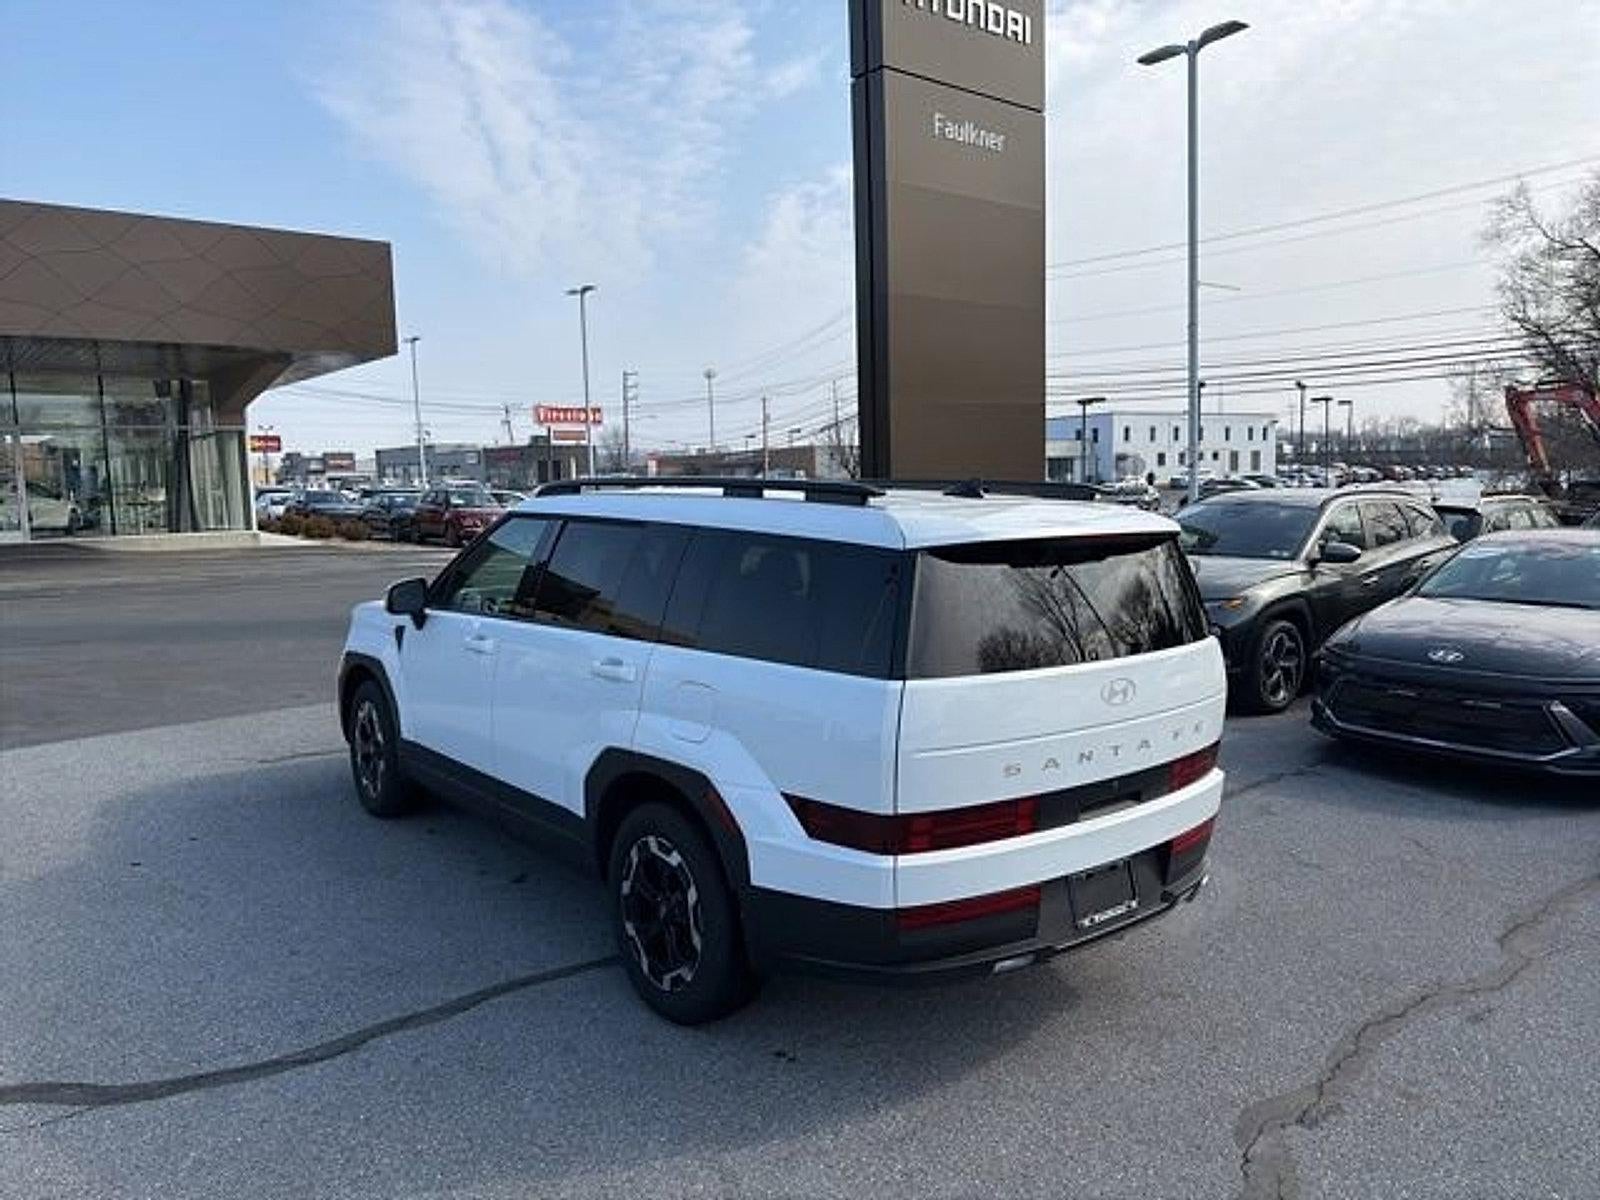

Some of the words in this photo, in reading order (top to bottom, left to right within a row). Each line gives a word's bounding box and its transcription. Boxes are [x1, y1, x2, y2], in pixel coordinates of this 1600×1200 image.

[904, 0, 1031, 44] UNDAI
[934, 112, 1006, 151] Faulkner
[1003, 739, 1152, 778] SANTA
